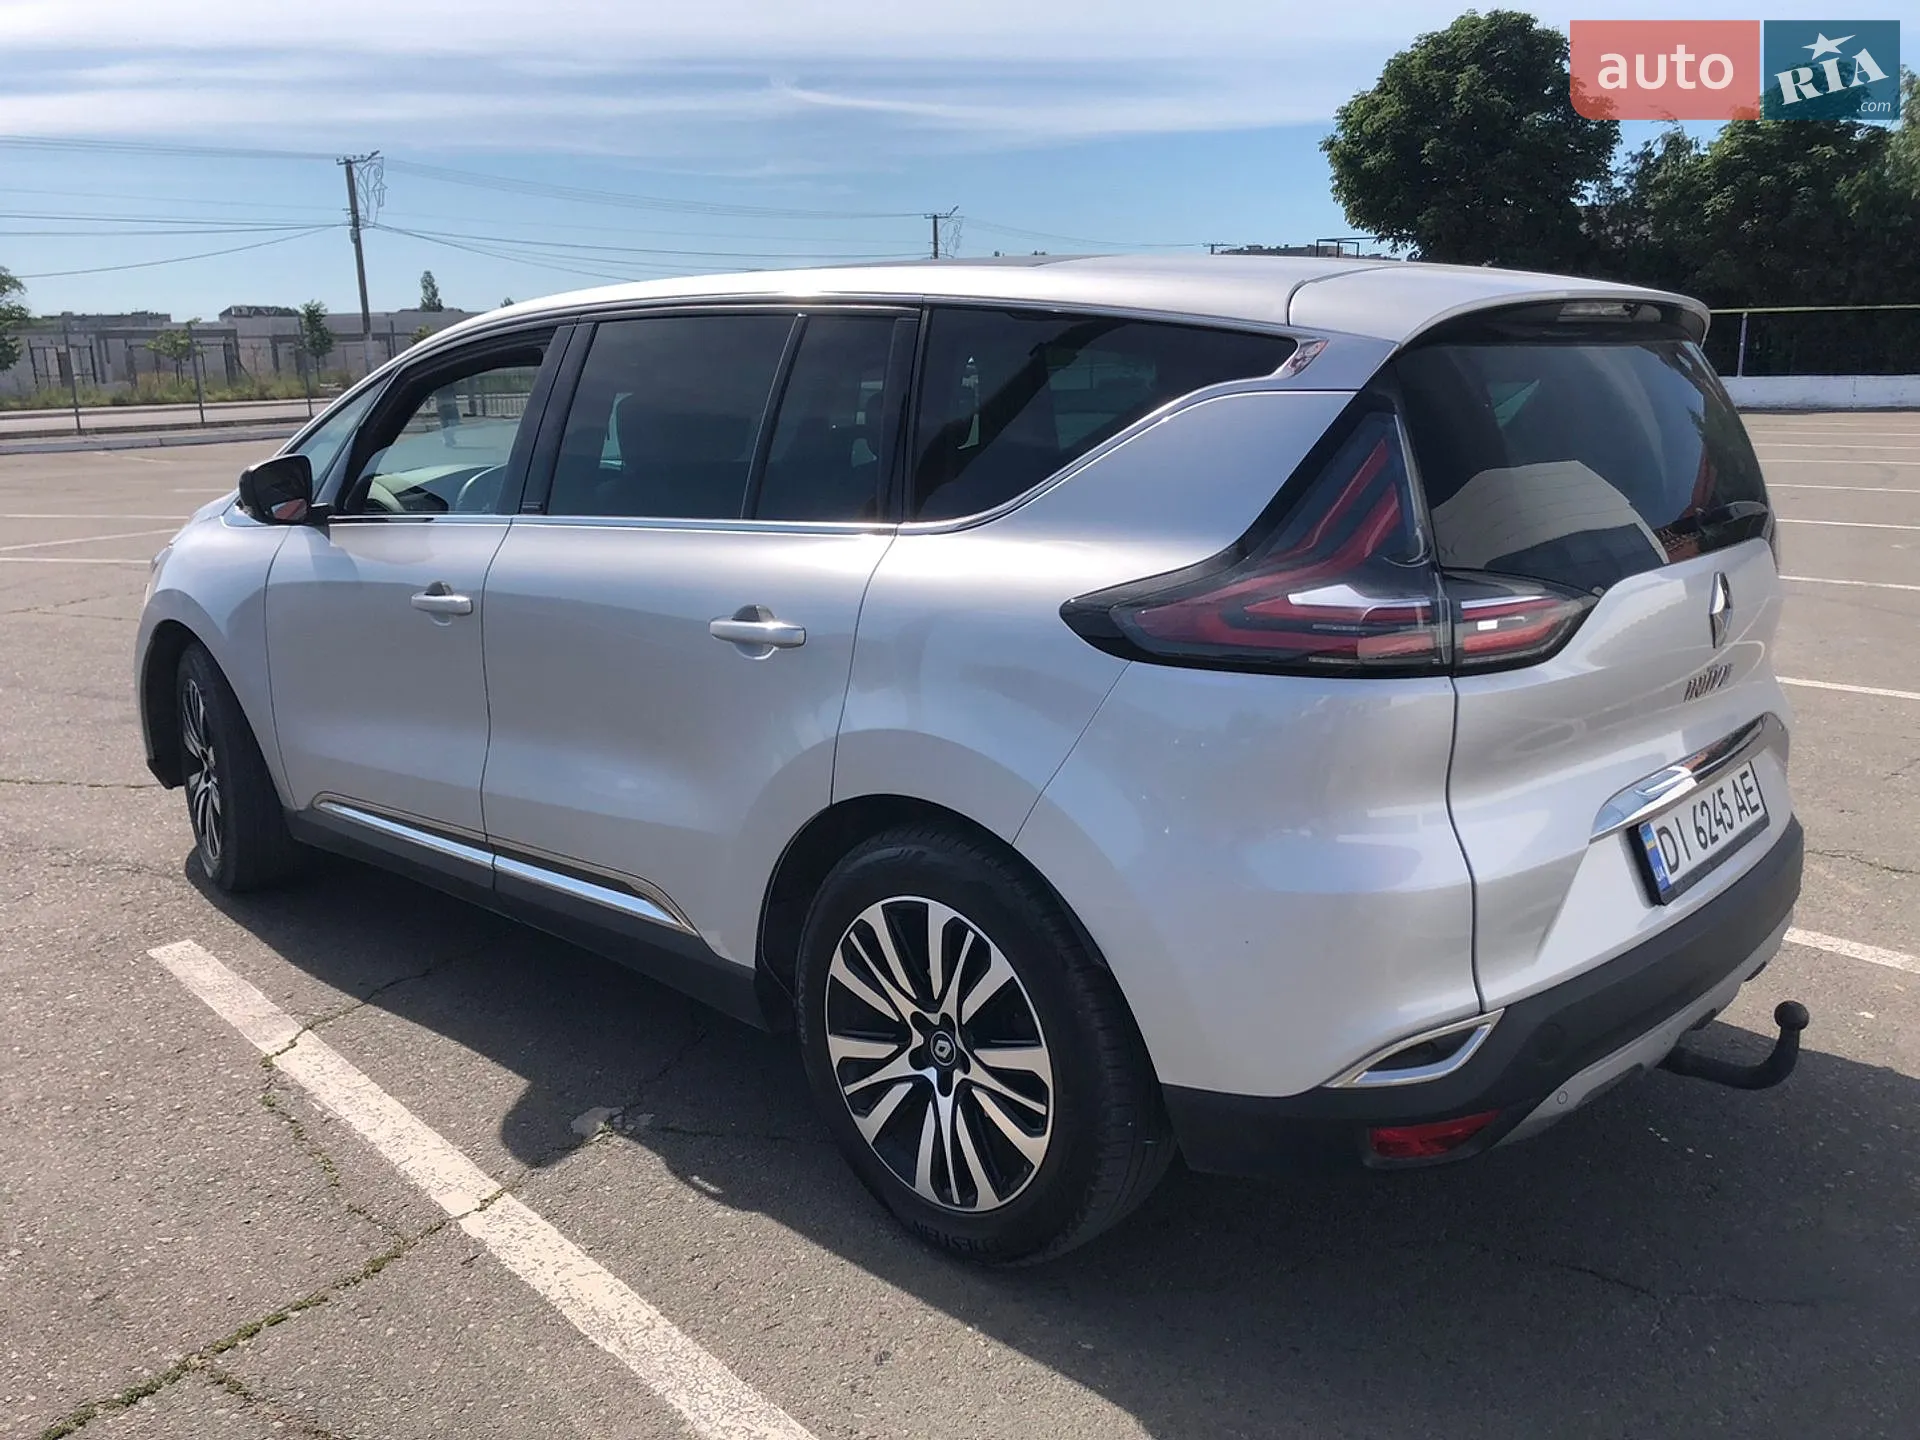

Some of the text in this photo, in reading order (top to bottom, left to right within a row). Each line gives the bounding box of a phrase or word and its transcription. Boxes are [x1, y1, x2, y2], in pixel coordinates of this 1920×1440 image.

[1656, 770, 1760, 875] DI 6245 AE
